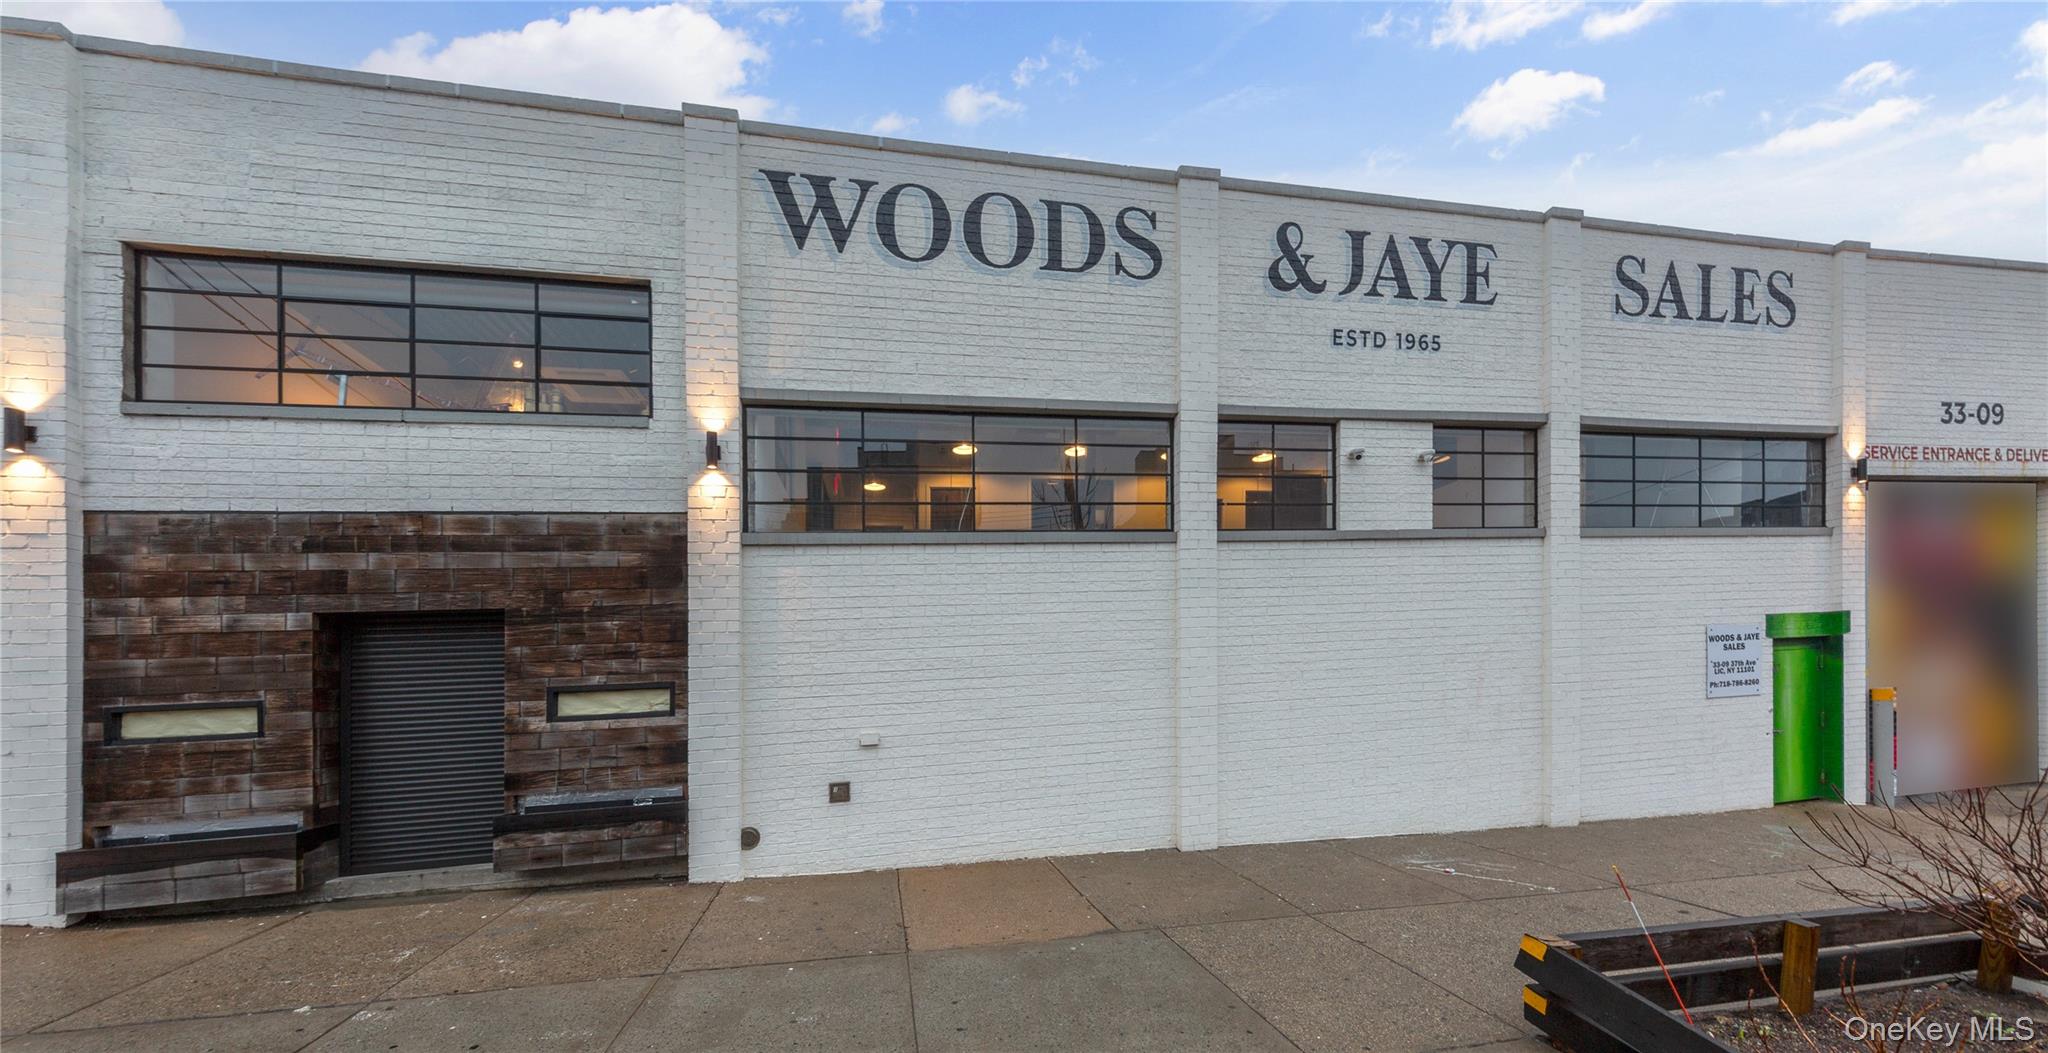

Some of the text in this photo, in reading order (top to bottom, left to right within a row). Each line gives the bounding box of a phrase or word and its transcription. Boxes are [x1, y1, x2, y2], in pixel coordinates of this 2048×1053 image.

[758, 168, 1797, 328] WOODS & JAYE SALES
[1332, 327, 1442, 351] ESTD 1965
[1939, 400, 2005, 426] 33-09
[1864, 444, 1918, 461] SERVICE
[1922, 445, 1991, 462] ENTRANCE
[1994, 447, 2003, 462] &
[1709, 634, 1735, 643] WOODS
[1743, 633, 1760, 641] JAYE
